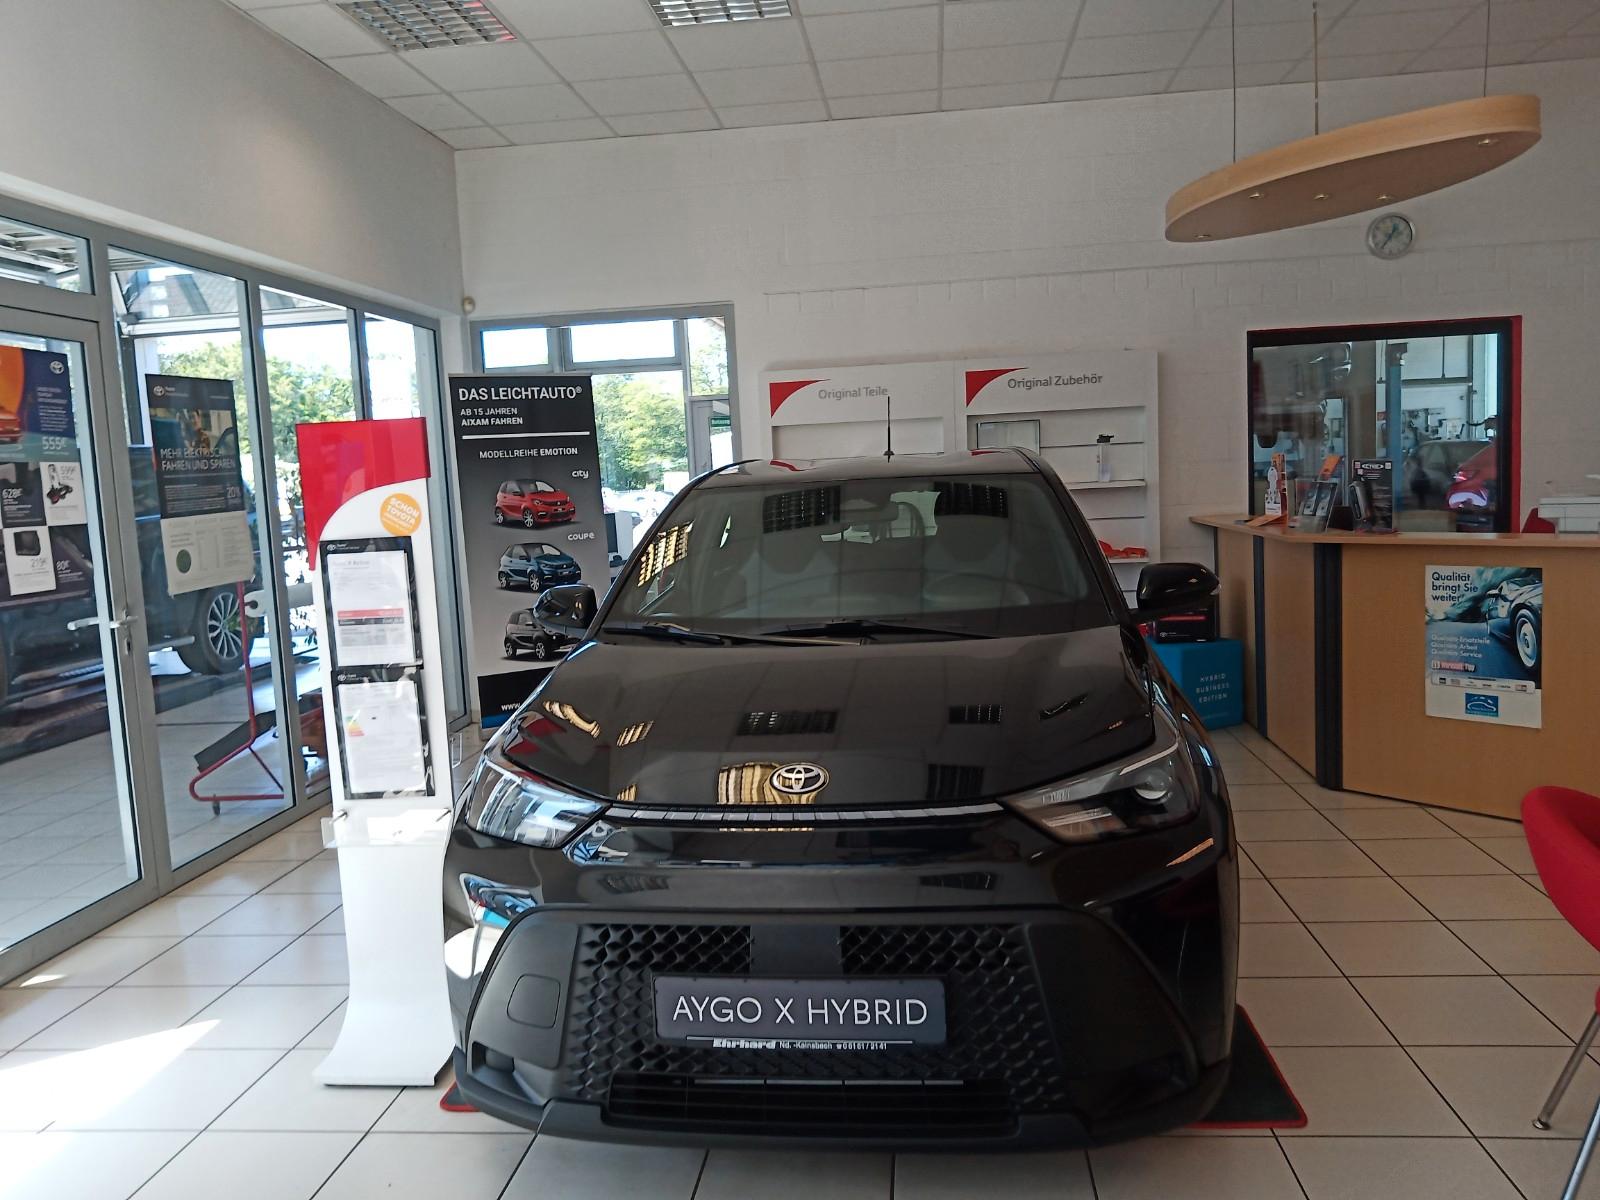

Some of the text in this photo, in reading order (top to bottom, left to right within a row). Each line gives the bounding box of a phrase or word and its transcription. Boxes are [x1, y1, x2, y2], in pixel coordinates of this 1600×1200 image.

[1007, 374, 1103, 391] Original Zubehör
[458, 386, 583, 401] DAS LEICHTAUTO®
[818, 386, 888, 401] Original Teile
[460, 407, 518, 416] AB 15 JAHREN
[461, 417, 523, 426] AIXAM FAHREN
[480, 447, 578, 459] MODELLREIHE EMOTION
[571, 470, 589, 479] city
[1431, 571, 1471, 582] Qualität
[1431, 583, 1479, 593] bringt Sie
[1200, 673, 1226, 682] HYBRID
[1196, 682, 1229, 692] BUSINESS
[1199, 693, 1227, 703] EDITION
[673, 995, 928, 1025] AYGO X HYBRID
